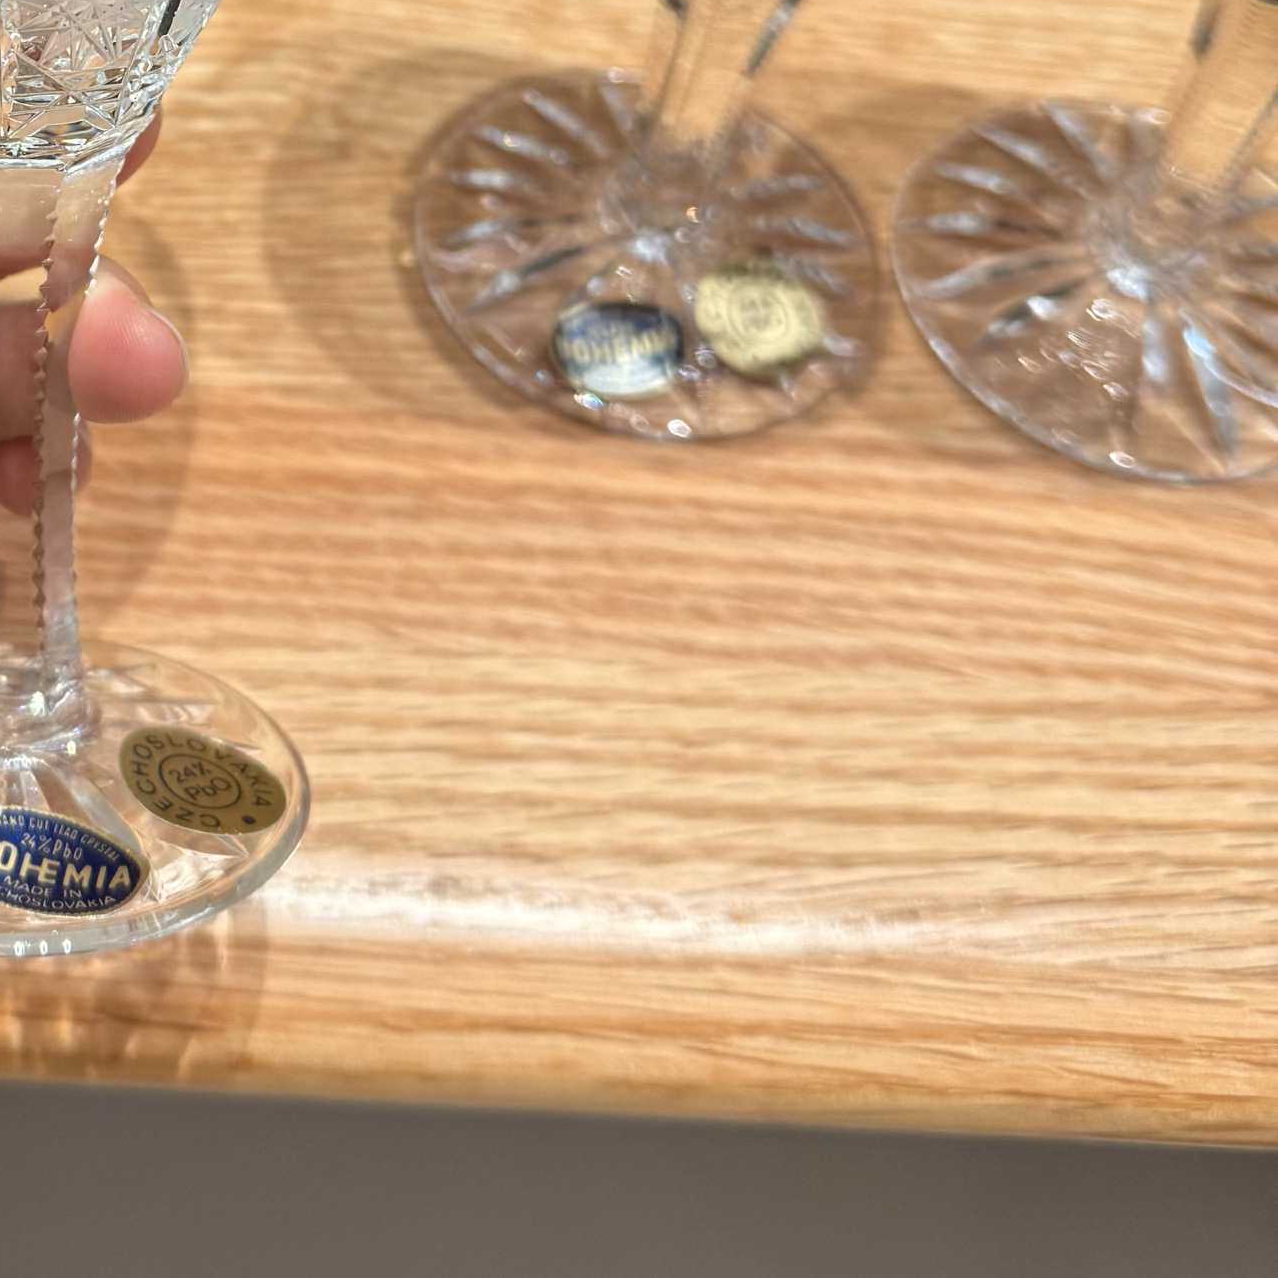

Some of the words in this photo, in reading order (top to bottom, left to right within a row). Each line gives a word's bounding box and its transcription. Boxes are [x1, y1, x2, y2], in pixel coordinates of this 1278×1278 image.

[131, 732, 273, 829] CZECHOSLOVAKIA
[168, 761, 212, 784] 24%
[184, 777, 232, 801] PbO
[20, 832, 51, 854] 24%
[52, 838, 83, 861] PbO
[29, 817, 50, 831] CUT
[53, 823, 79, 840] LEAD
[80, 833, 121, 862] CRYSTAL
[3, 874, 53, 897] MADE
[63, 888, 83, 898] IN
